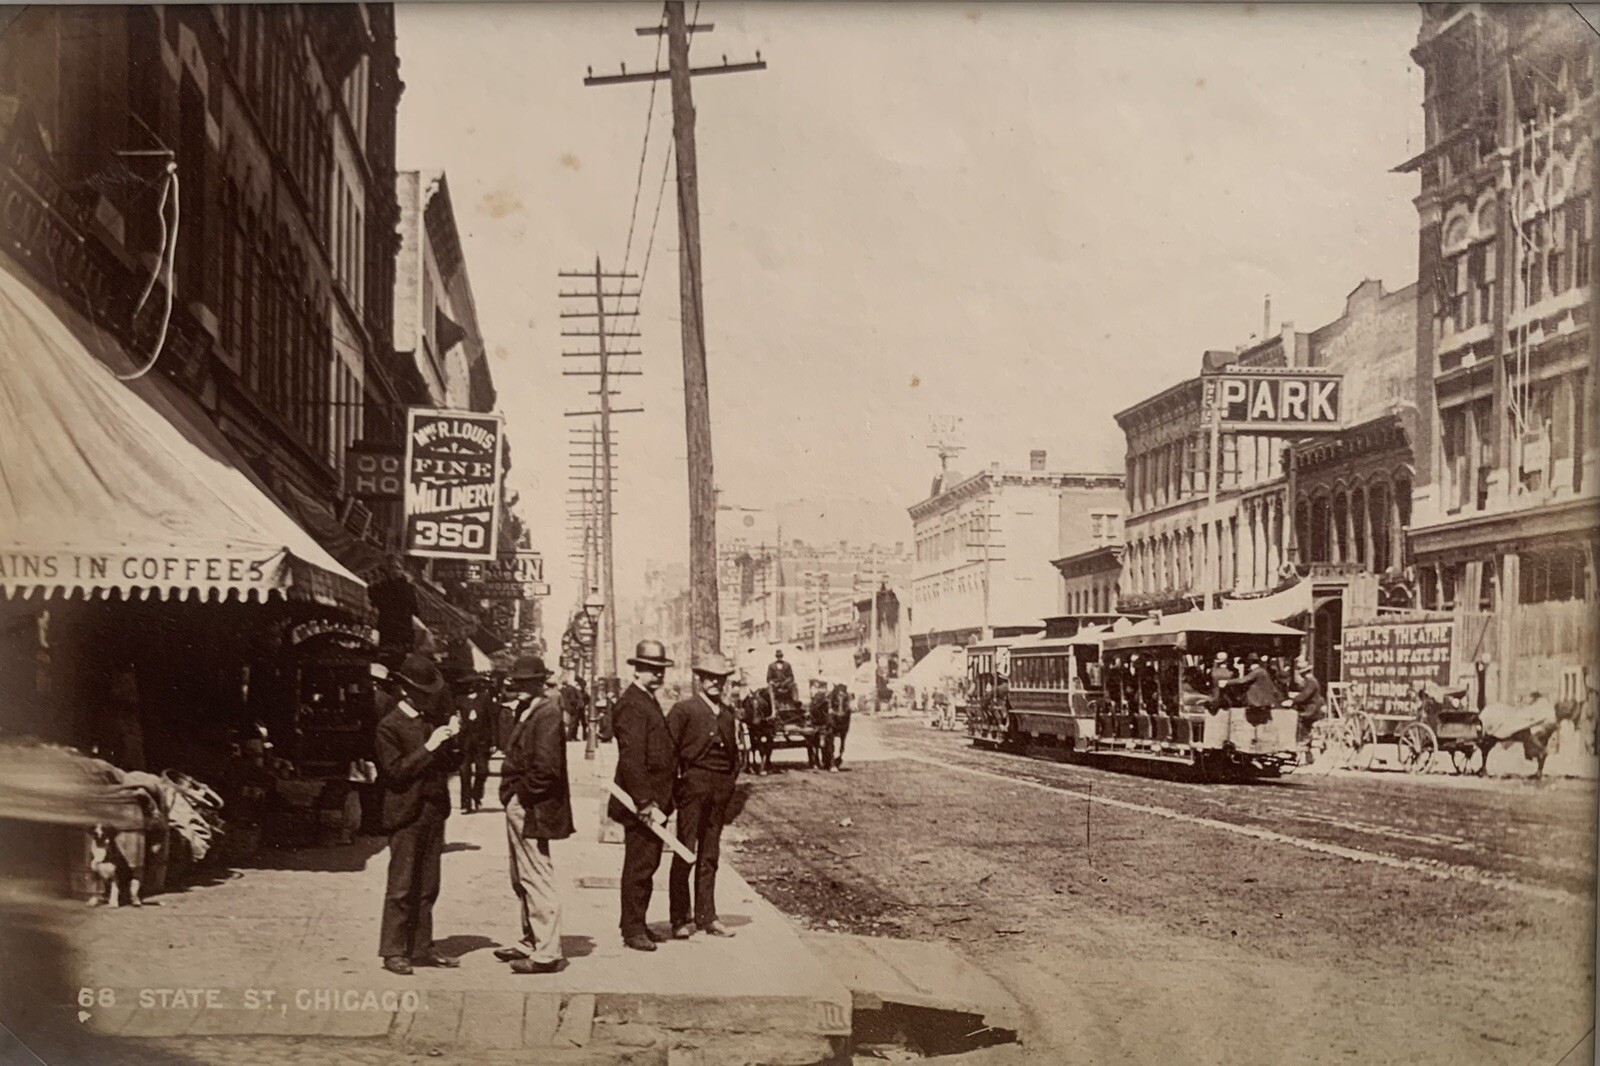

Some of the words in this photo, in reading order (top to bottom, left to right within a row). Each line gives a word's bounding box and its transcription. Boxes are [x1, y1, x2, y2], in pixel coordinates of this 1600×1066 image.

[1221, 380, 1336, 420] PARK
[414, 458, 492, 478] FINE
[405, 482, 495, 515] MILLINERY
[415, 520, 485, 549] 350
[75, 556, 108, 579] IN
[122, 557, 264, 582] COFFEES
[1394, 626, 1450, 645] THEATRE
[1360, 650, 1375, 664] TO
[1396, 648, 1432, 663] STATE
